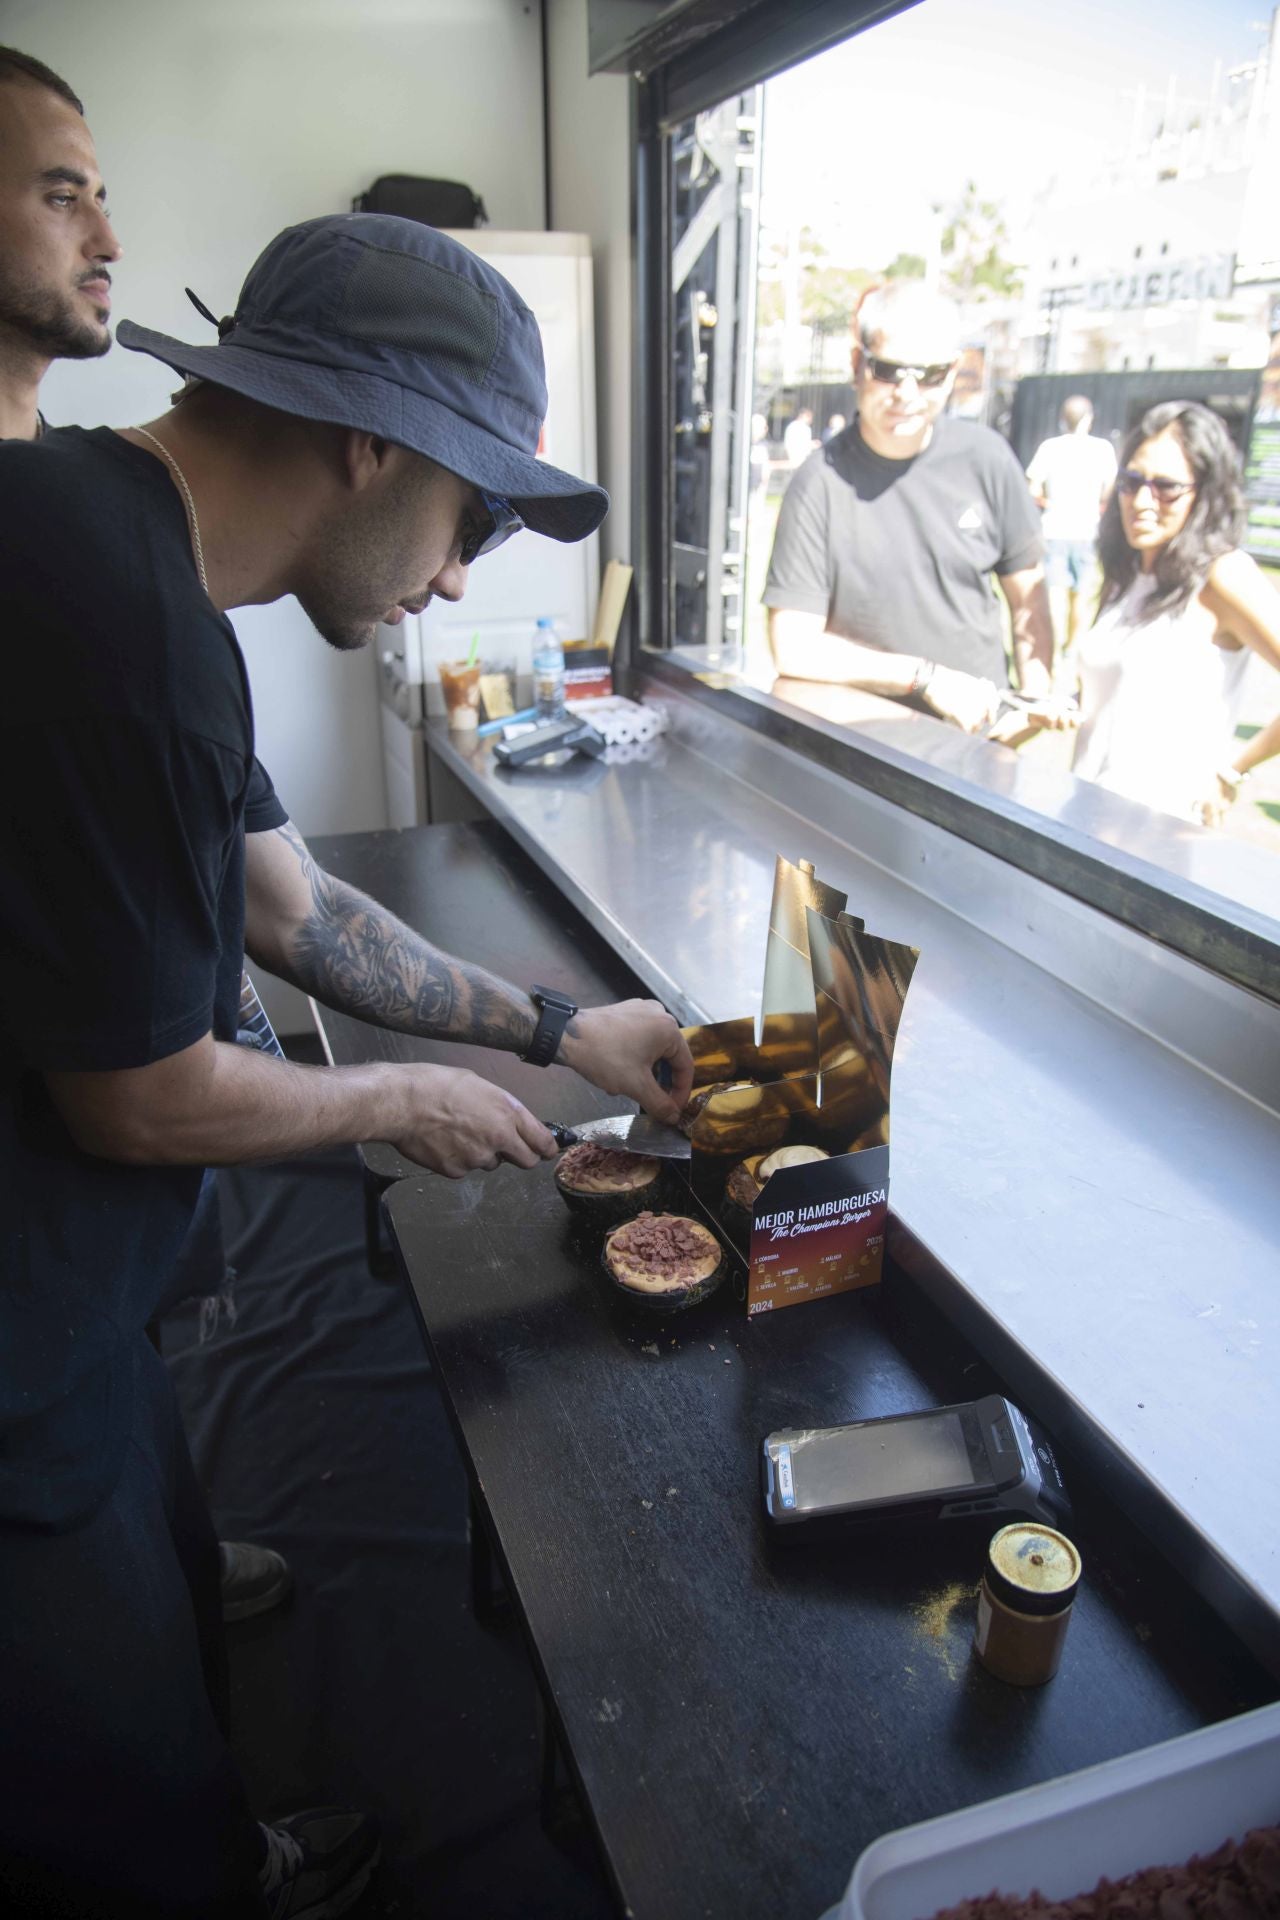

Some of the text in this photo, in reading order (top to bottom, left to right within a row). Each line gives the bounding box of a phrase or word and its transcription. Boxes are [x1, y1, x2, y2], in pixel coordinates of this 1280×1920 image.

[754, 1188, 886, 1231] MEJOR HAMBURGUESA
[769, 1208, 872, 1242] The Champions Burger
[750, 1299, 773, 1314] 2024
